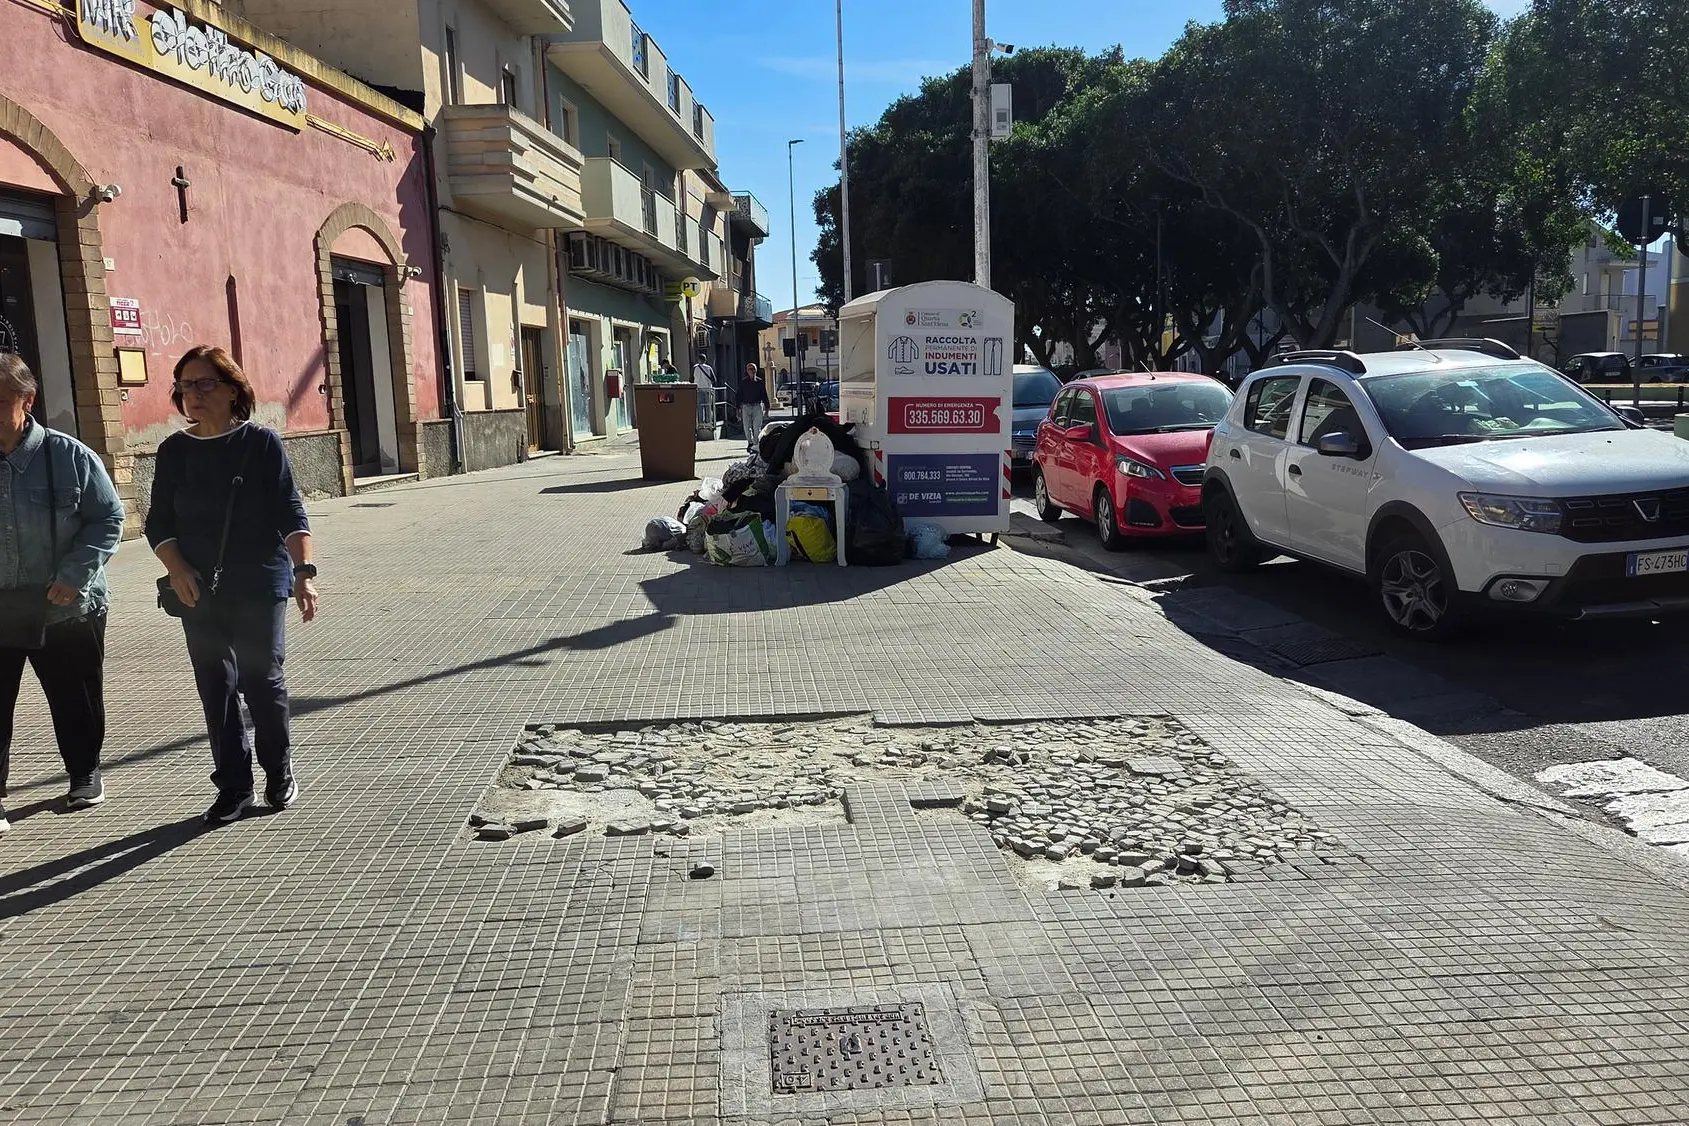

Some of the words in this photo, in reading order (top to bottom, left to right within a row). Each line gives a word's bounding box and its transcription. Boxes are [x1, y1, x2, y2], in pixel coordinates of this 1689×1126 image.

[683, 282, 697, 291] PT
[925, 336, 977, 345] RACCOLTA
[925, 352, 977, 360] INDUMENTI
[925, 362, 977, 375] USATI
[909, 409, 981, 424] 335.569.63.30
[903, 470, 941, 481] 800.784.333
[1331, 463, 1370, 478] STEPWAY
[909, 492, 920, 500] DE
[921, 492, 942, 500] VIZIA
